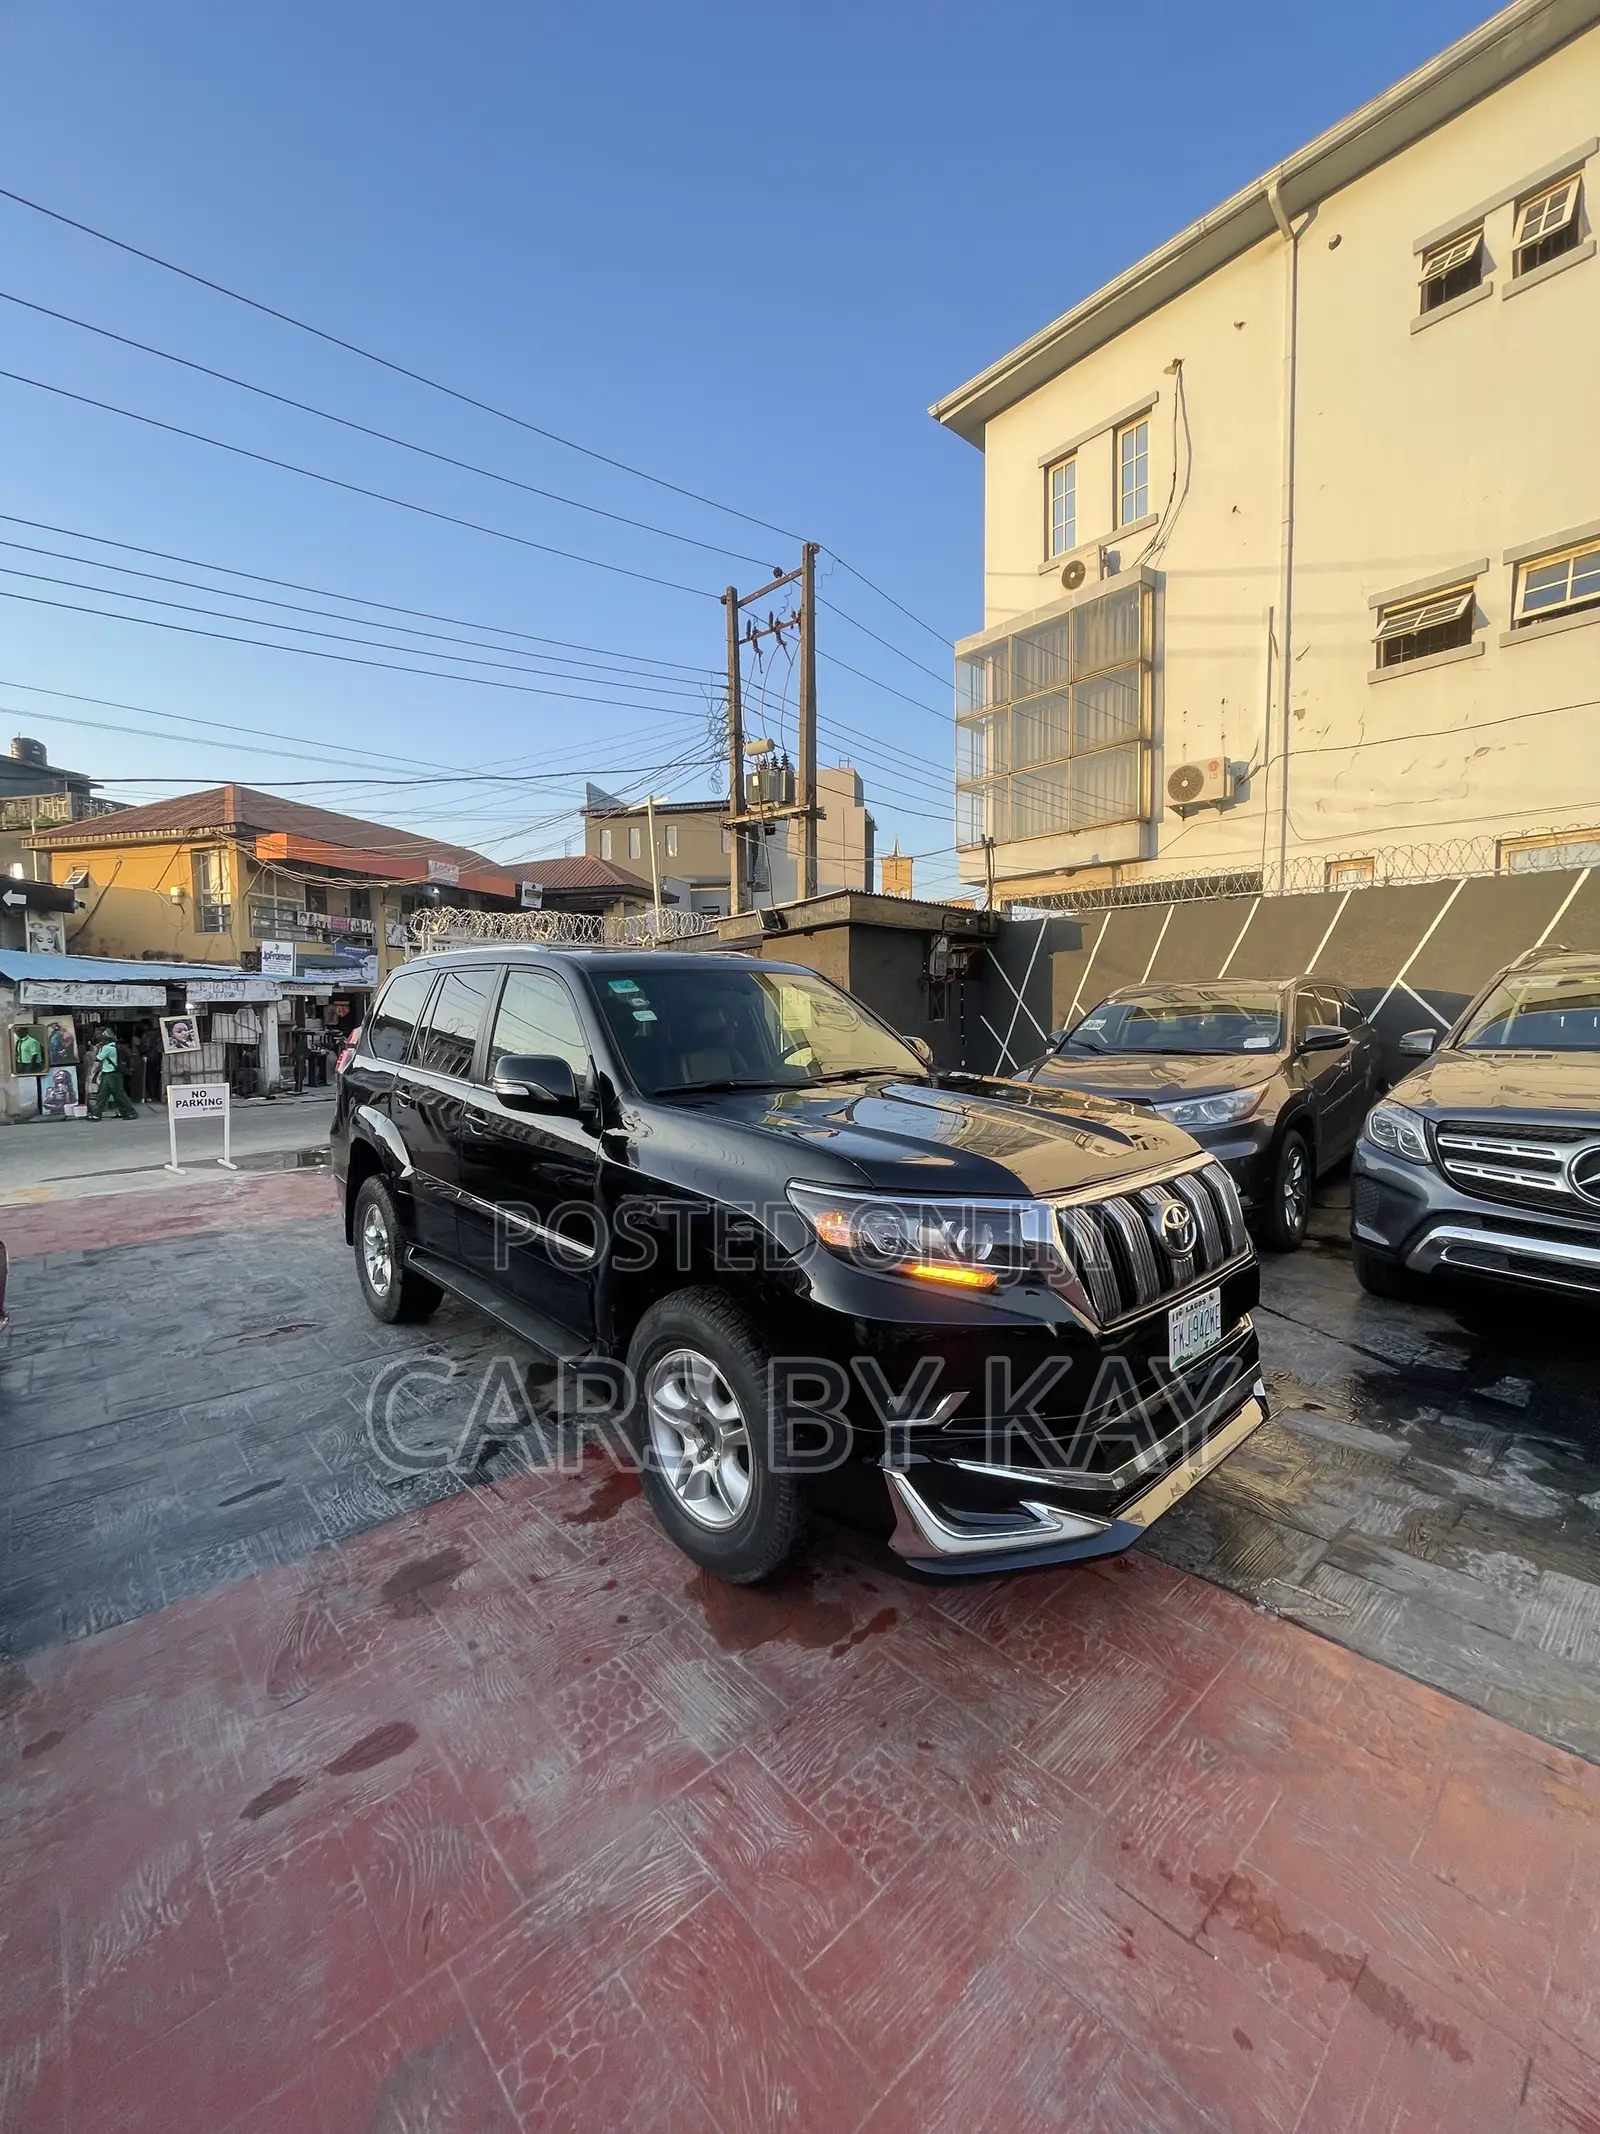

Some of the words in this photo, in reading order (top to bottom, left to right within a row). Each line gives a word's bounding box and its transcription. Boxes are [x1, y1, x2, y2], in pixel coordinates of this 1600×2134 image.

[191, 1090, 207, 1098] NO
[175, 1097, 223, 1108] PARKING
[1185, 1298, 1206, 1313] LAGOS
